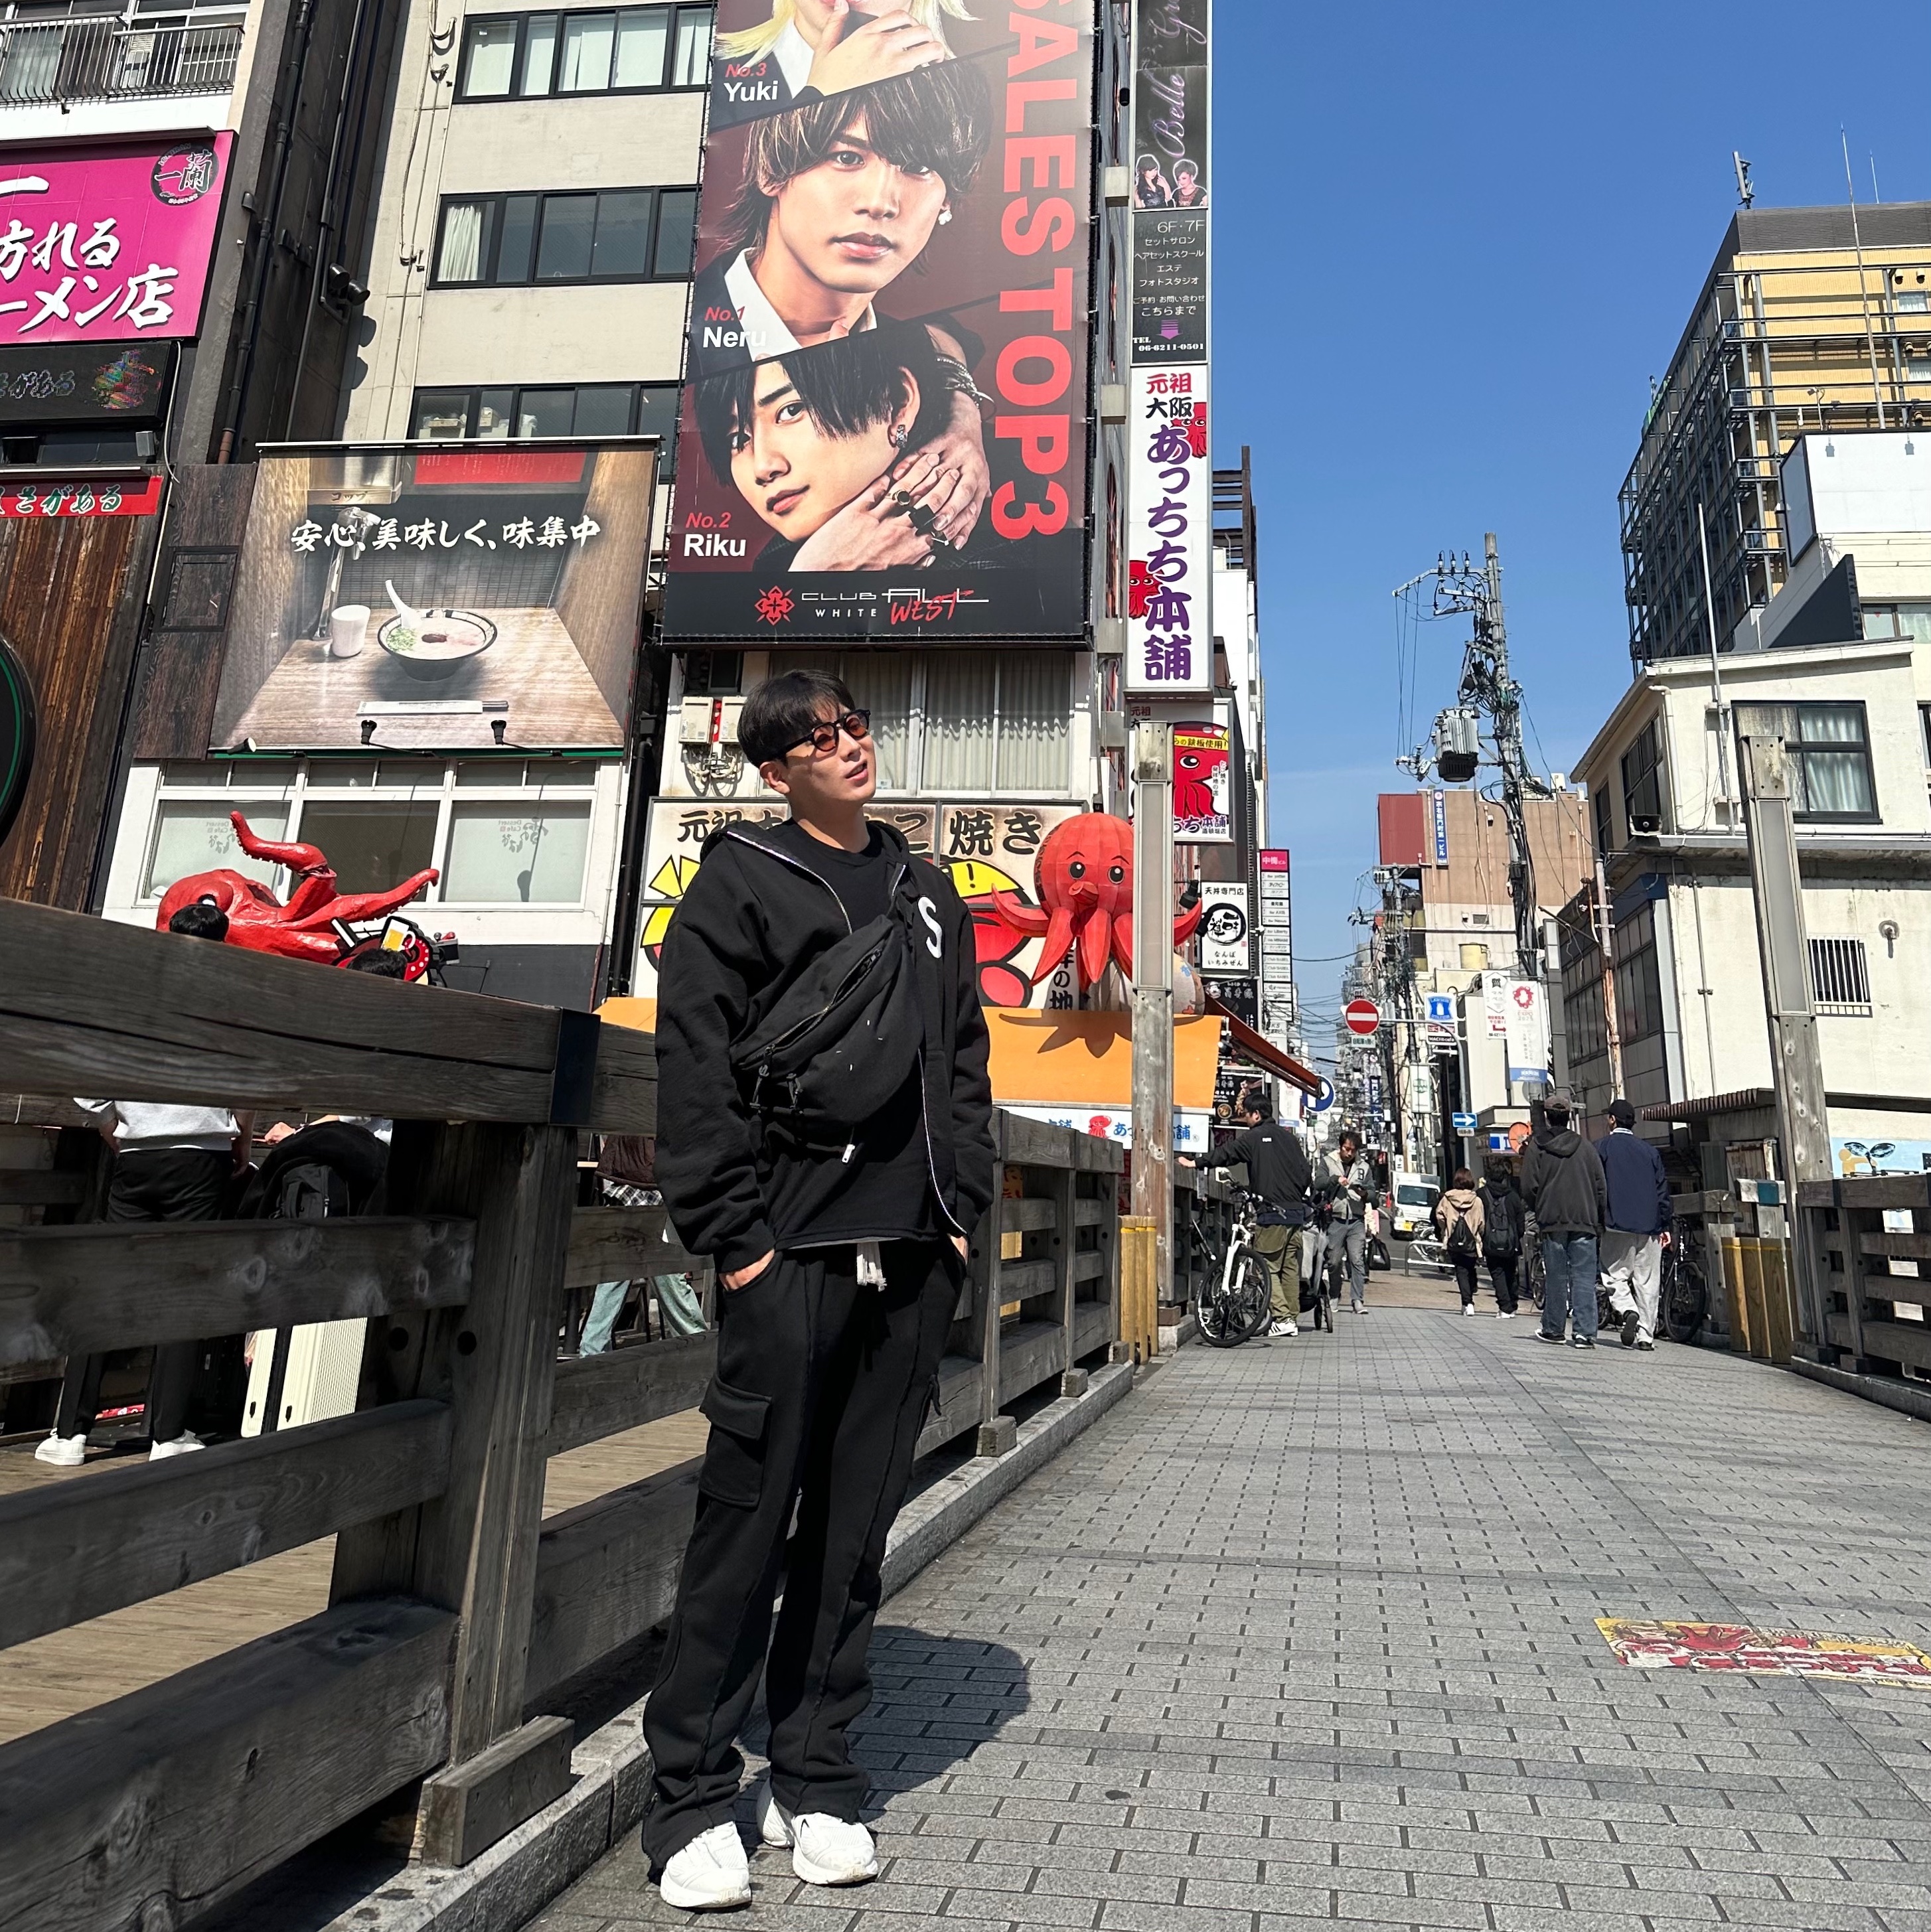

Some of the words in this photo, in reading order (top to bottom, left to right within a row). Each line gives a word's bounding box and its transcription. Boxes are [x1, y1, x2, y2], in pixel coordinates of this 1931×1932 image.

[725, 63, 767, 78] No.3
[724, 80, 778, 102] Yuki
[1000, 0, 1079, 257] ALES
[154, 149, 212, 193] 一蘭
[1145, 237, 1196, 246] セットサロン
[1134, 250, 1204, 260] ヘアセットスクール
[1139, 277, 1199, 287] フォトスタジオ
[704, 306, 745, 321] No.1
[1141, 306, 1196, 317] こちらまで
[702, 327, 767, 348] Neru
[1146, 372, 1192, 394] 元祖
[1146, 398, 1192, 419] 大阪
[685, 512, 732, 529] No.2
[683, 534, 747, 557] Riku
[1144, 424, 1192, 681] あっちち本舗
[815, 609, 877, 617] WHITE
[890, 589, 974, 625] WEST
[1130, 706, 1151, 716] 元祖
[1205, 887, 1245, 895] 天丼専門店
[918, 896, 943, 959] S
